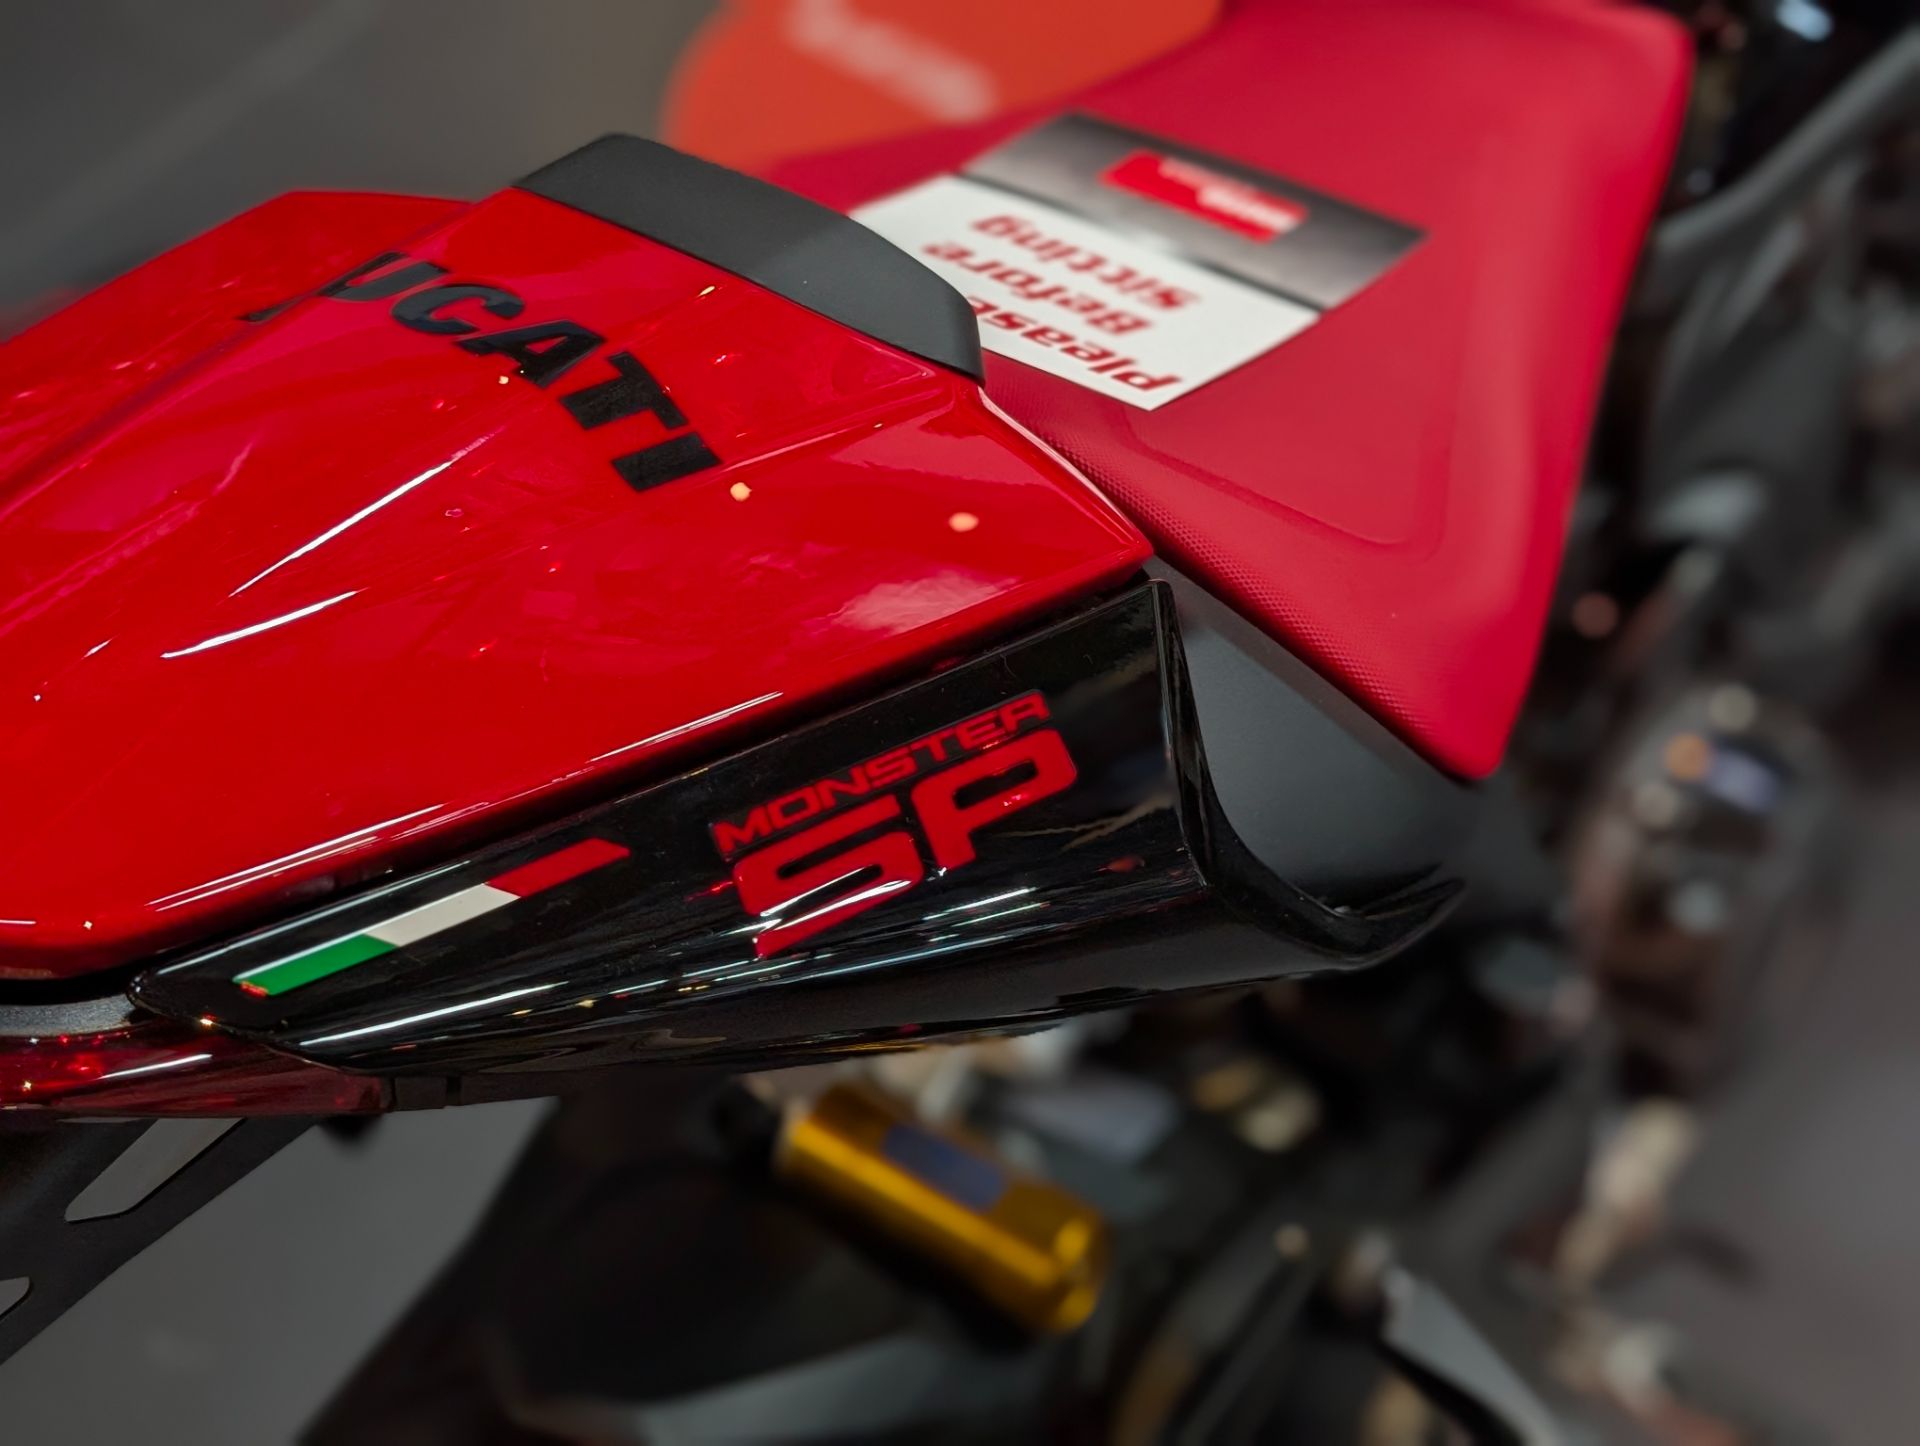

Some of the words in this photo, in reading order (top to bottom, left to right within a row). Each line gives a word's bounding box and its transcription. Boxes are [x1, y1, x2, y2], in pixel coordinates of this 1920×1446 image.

[921, 242, 1152, 336] Before
[971, 214, 1200, 310] Sitting
[240, 252, 722, 492] UCATI
[712, 690, 1051, 853] MONSTER
[734, 728, 1077, 958] SP
